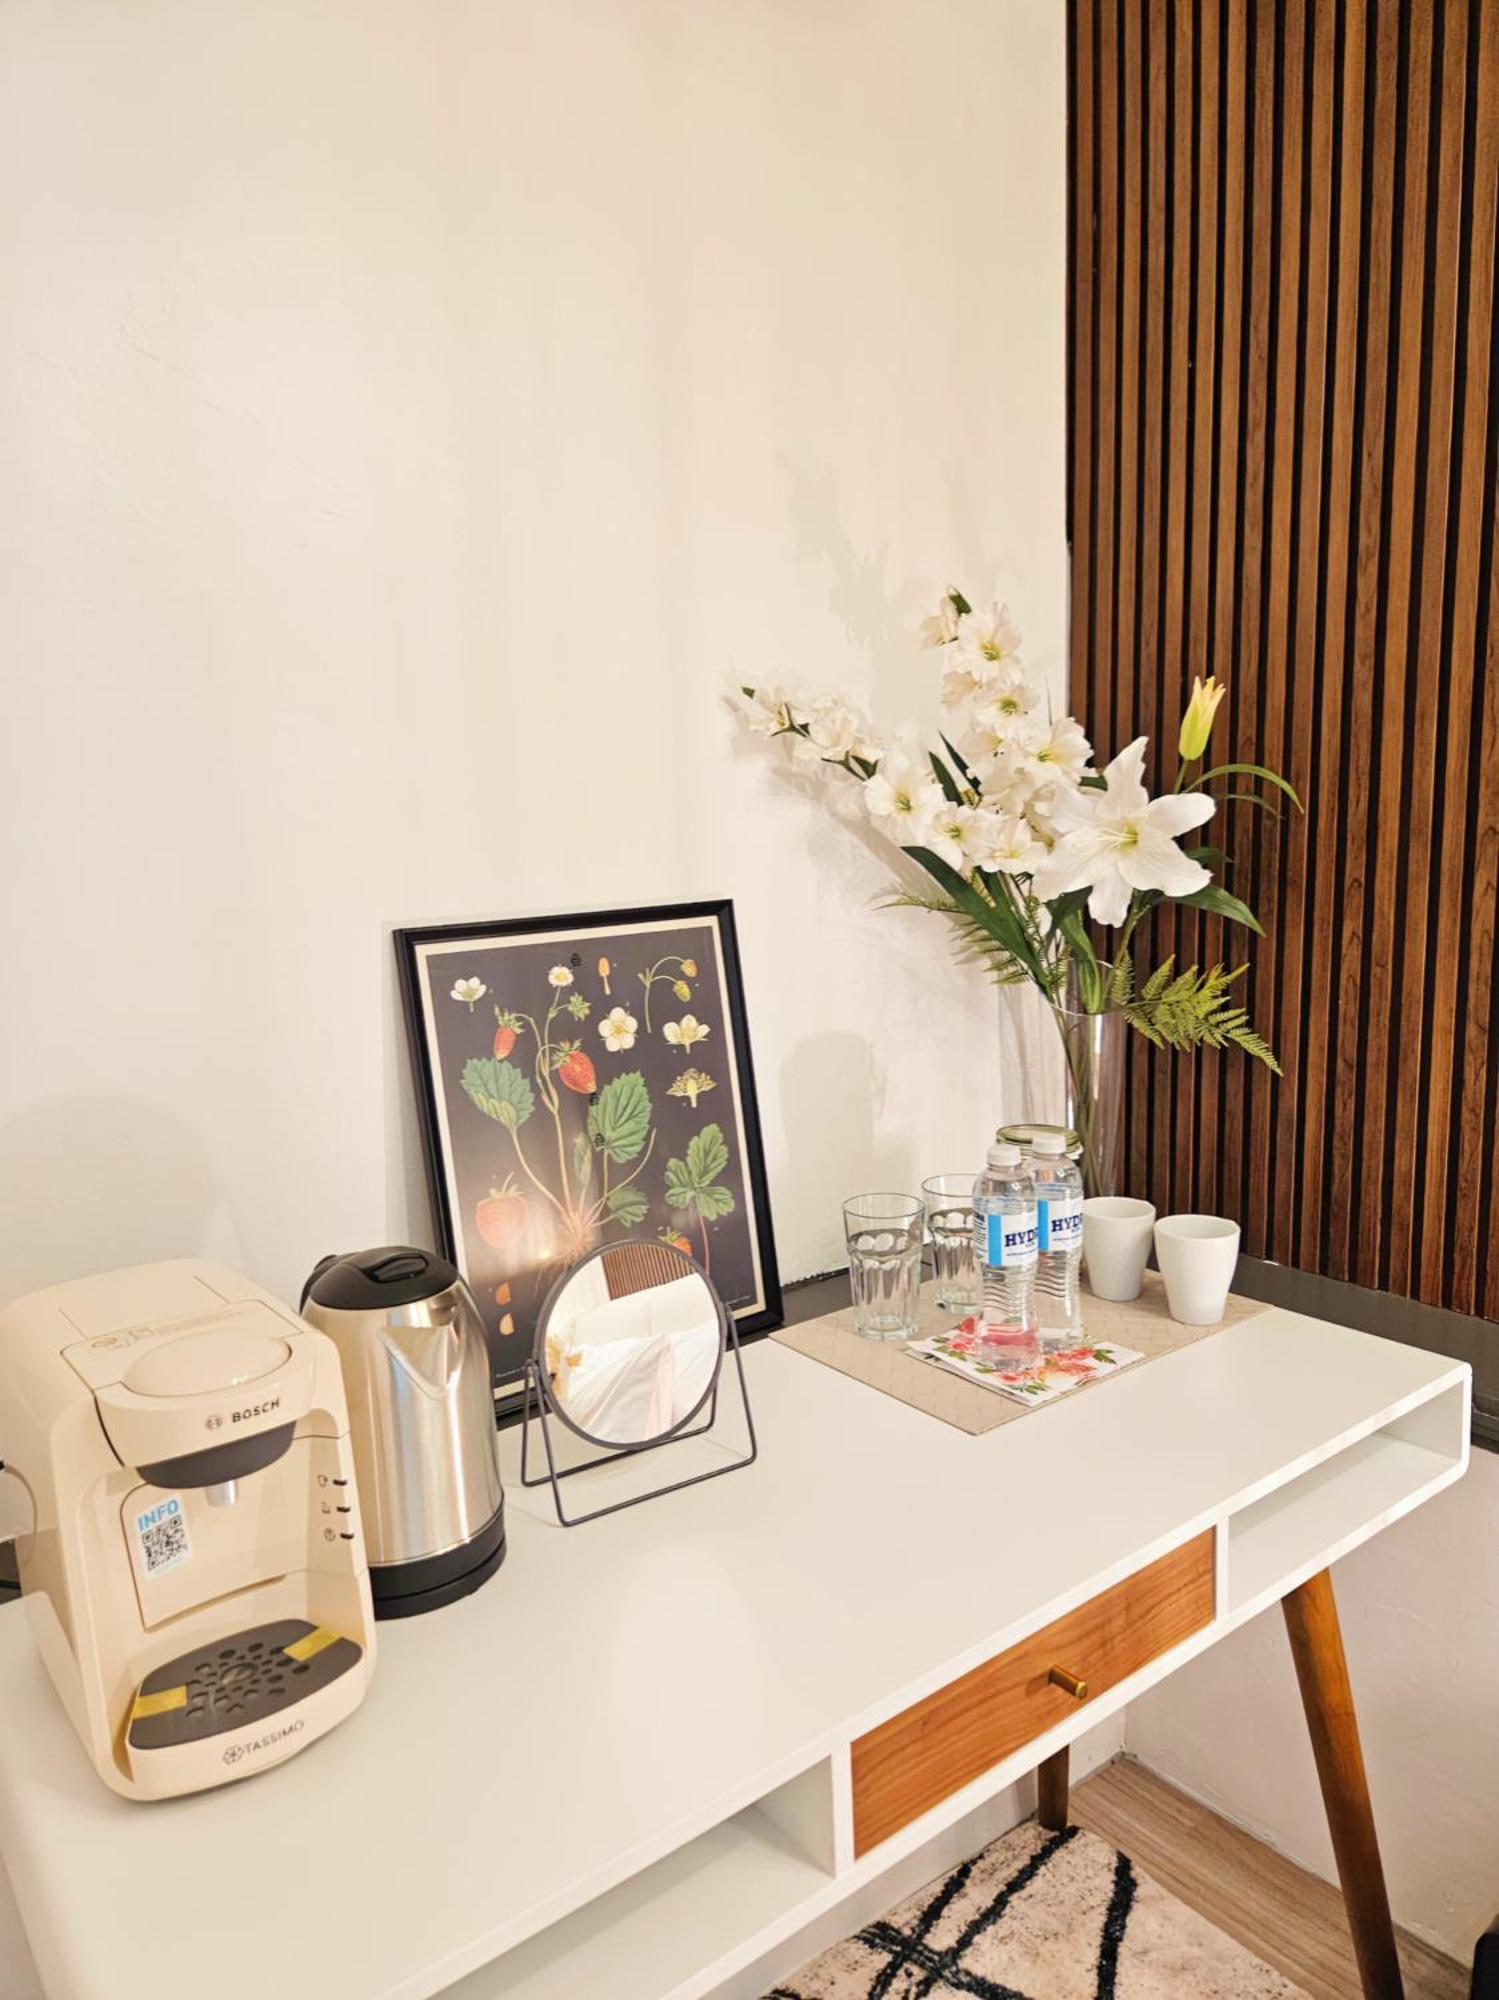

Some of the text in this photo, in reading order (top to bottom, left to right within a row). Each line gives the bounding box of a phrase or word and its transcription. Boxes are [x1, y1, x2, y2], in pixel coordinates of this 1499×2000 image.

[1004, 1226, 1038, 1247] HYD
[231, 1397, 281, 1424] BOSCH
[137, 1498, 180, 1532] INFO
[243, 1718, 306, 1754] TASSIMO
